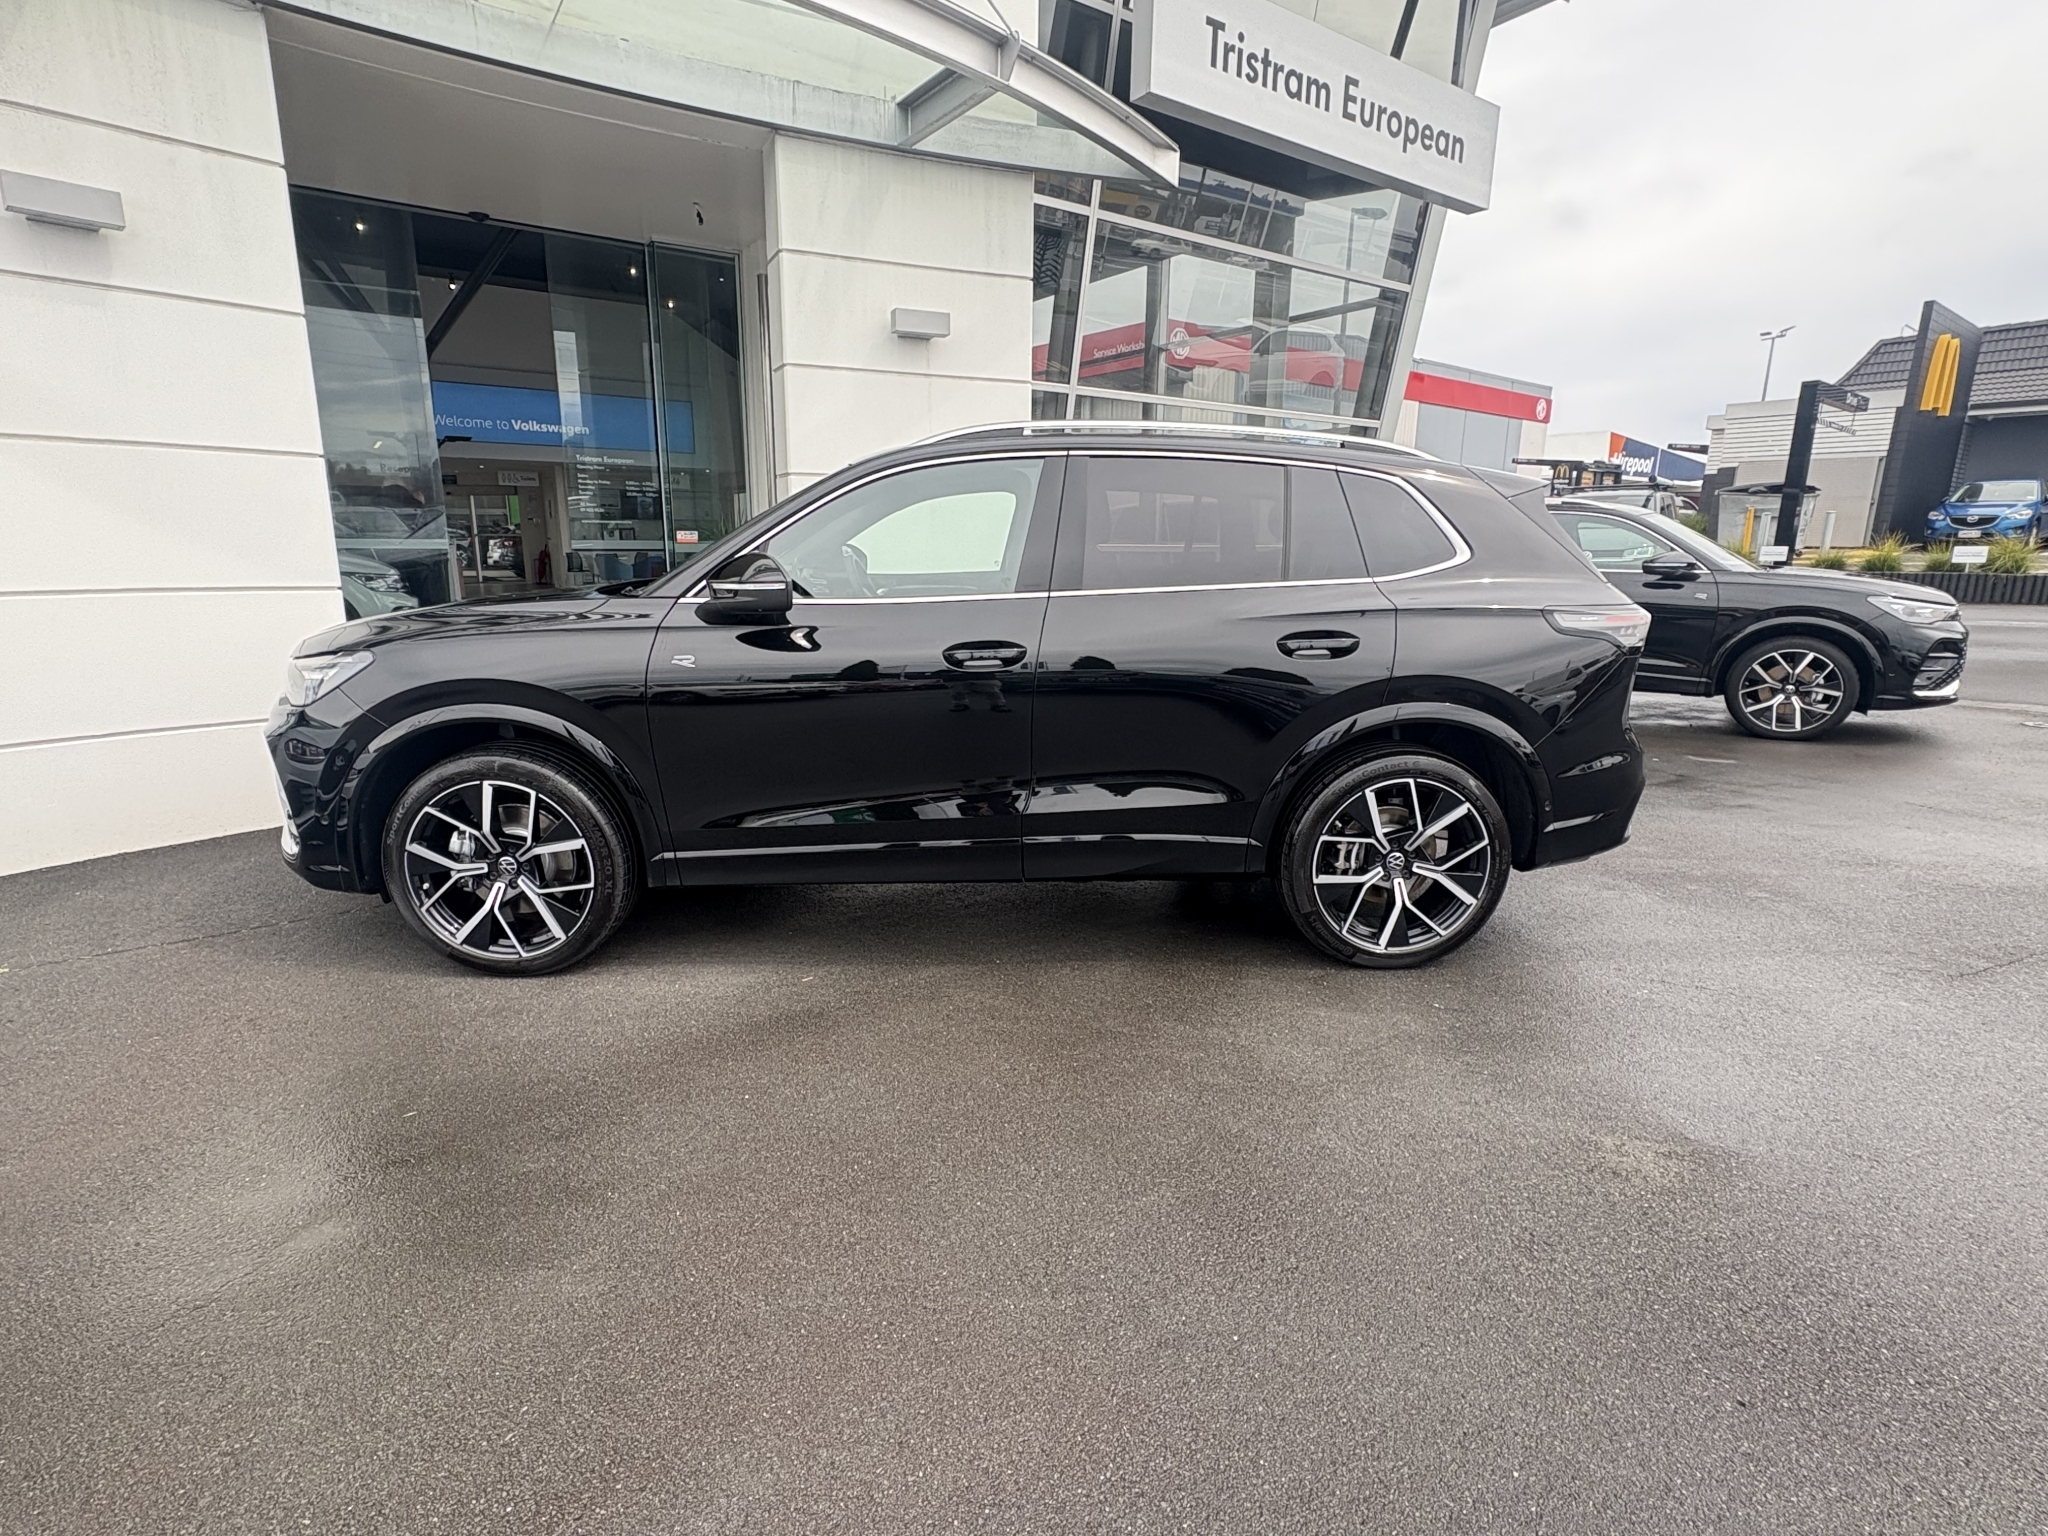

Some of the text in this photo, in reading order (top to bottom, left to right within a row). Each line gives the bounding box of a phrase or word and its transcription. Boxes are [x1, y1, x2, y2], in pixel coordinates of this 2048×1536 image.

[1206, 15, 1465, 164] Tristram European
[1093, 346, 1117, 358] Service
[435, 414, 590, 436] Welcome to Volkswagen
[603, 456, 635, 465] European
[1609, 451, 1655, 476] Hirepool
